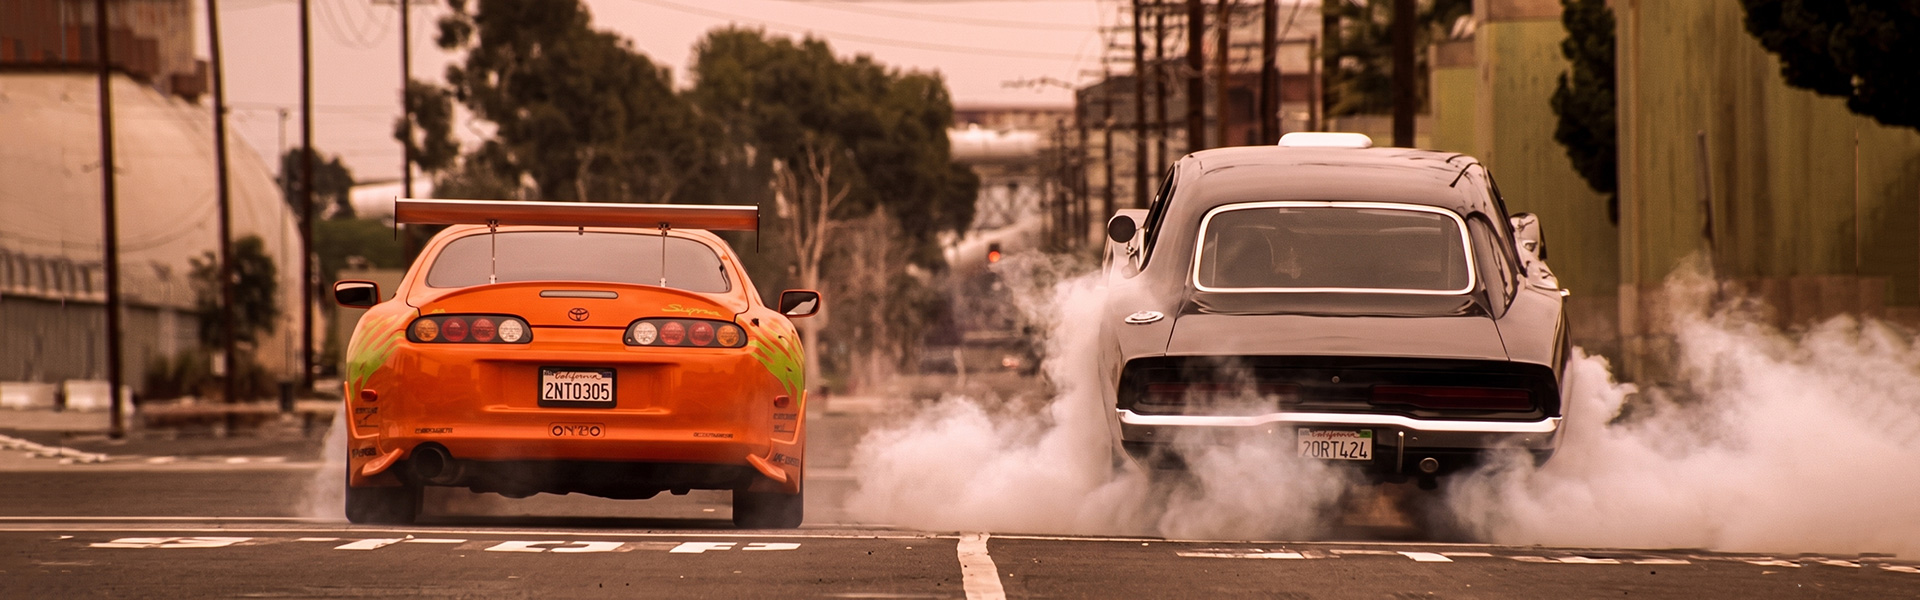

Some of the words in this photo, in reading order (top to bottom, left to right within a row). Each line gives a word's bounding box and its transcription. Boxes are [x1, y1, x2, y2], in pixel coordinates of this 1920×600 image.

[661, 304, 721, 317] Supra
[555, 371, 602, 382] California
[1311, 430, 1360, 440] California
